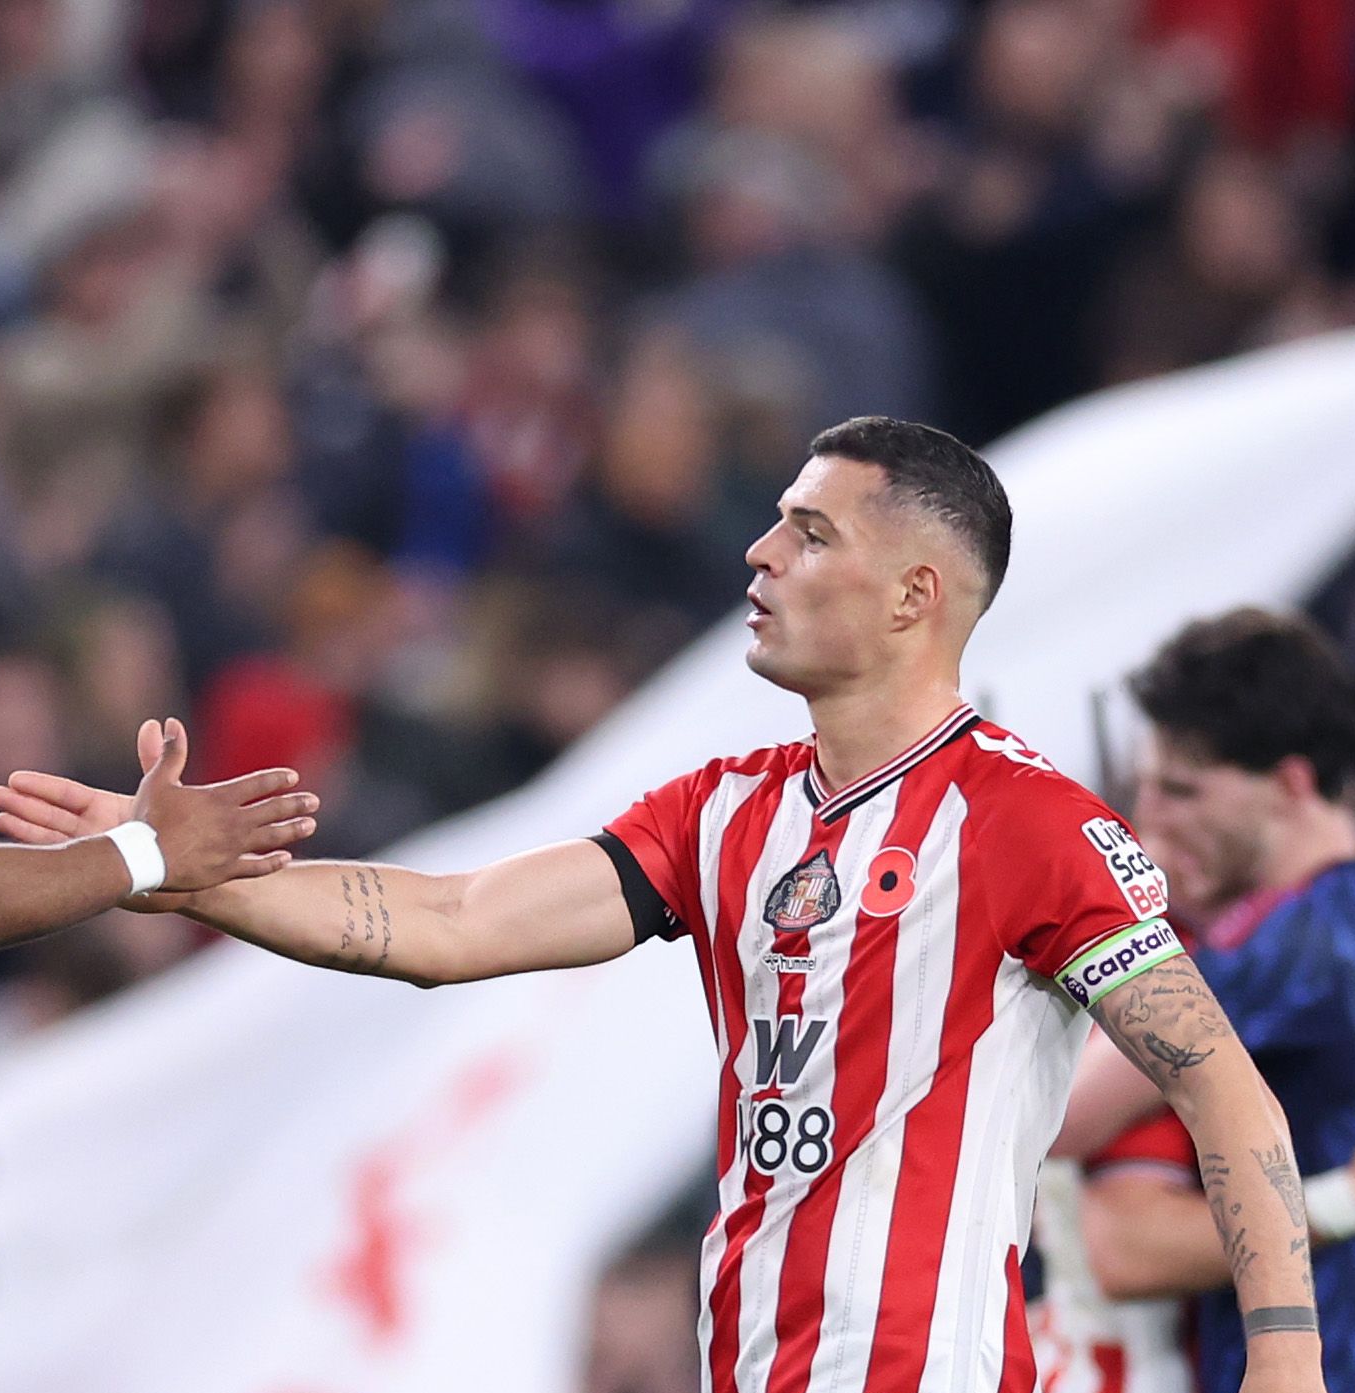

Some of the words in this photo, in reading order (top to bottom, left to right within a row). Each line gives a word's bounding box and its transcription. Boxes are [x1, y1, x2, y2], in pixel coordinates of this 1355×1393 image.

[1127, 875, 1167, 915] Bet
[780, 955, 817, 971] hummel
[1082, 925, 1176, 987] Captain
[753, 1019, 828, 1085] W
